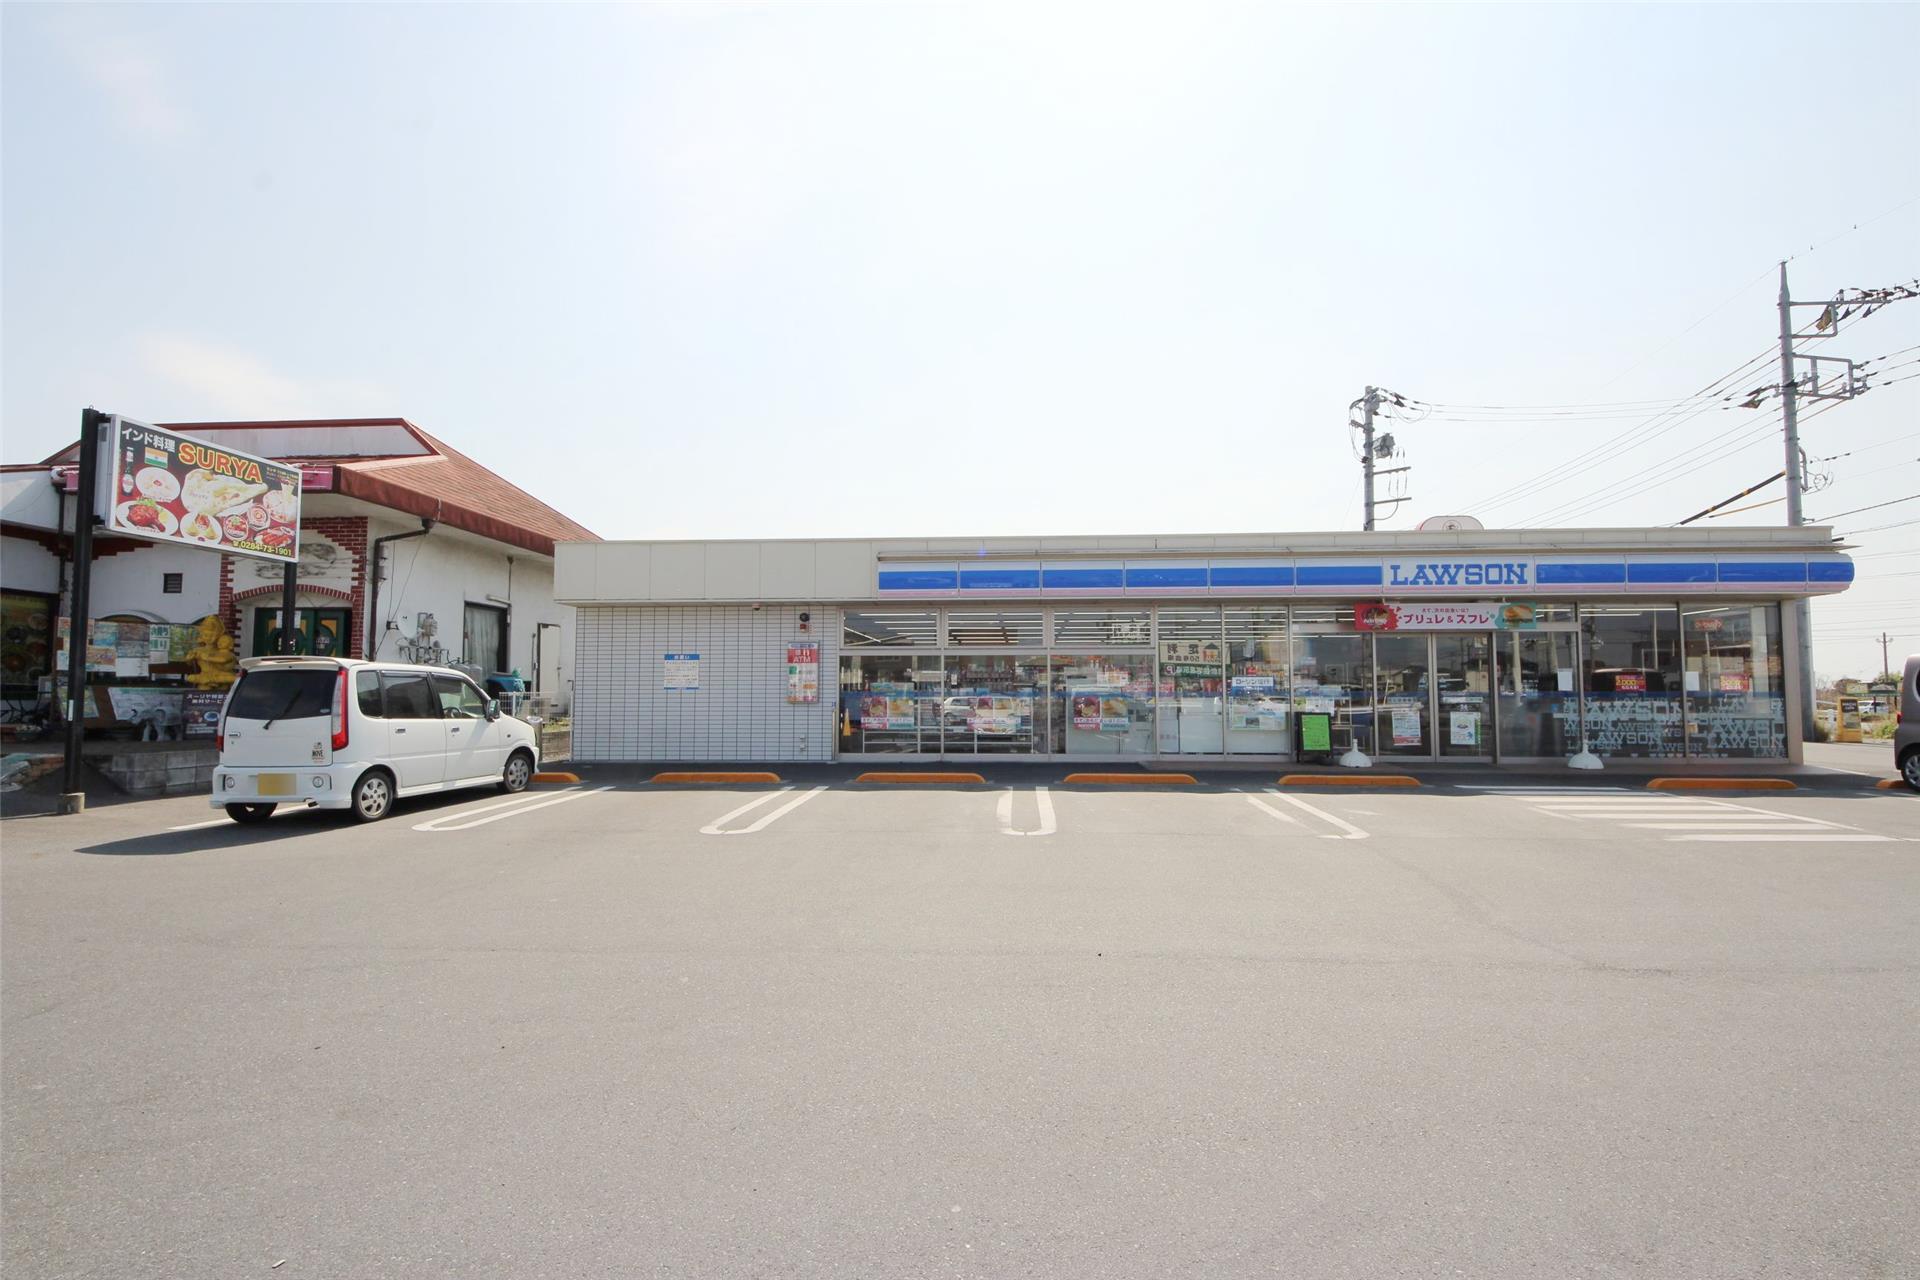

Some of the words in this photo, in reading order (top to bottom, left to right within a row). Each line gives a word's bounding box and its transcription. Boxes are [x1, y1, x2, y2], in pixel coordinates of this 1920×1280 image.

[122, 427, 176, 453] インド料理
[178, 442, 263, 483] SURYA
[1390, 563, 1528, 585] LAWSON
[1584, 732, 1662, 744] LAWSON
[1707, 736, 1784, 748] LAWSON
